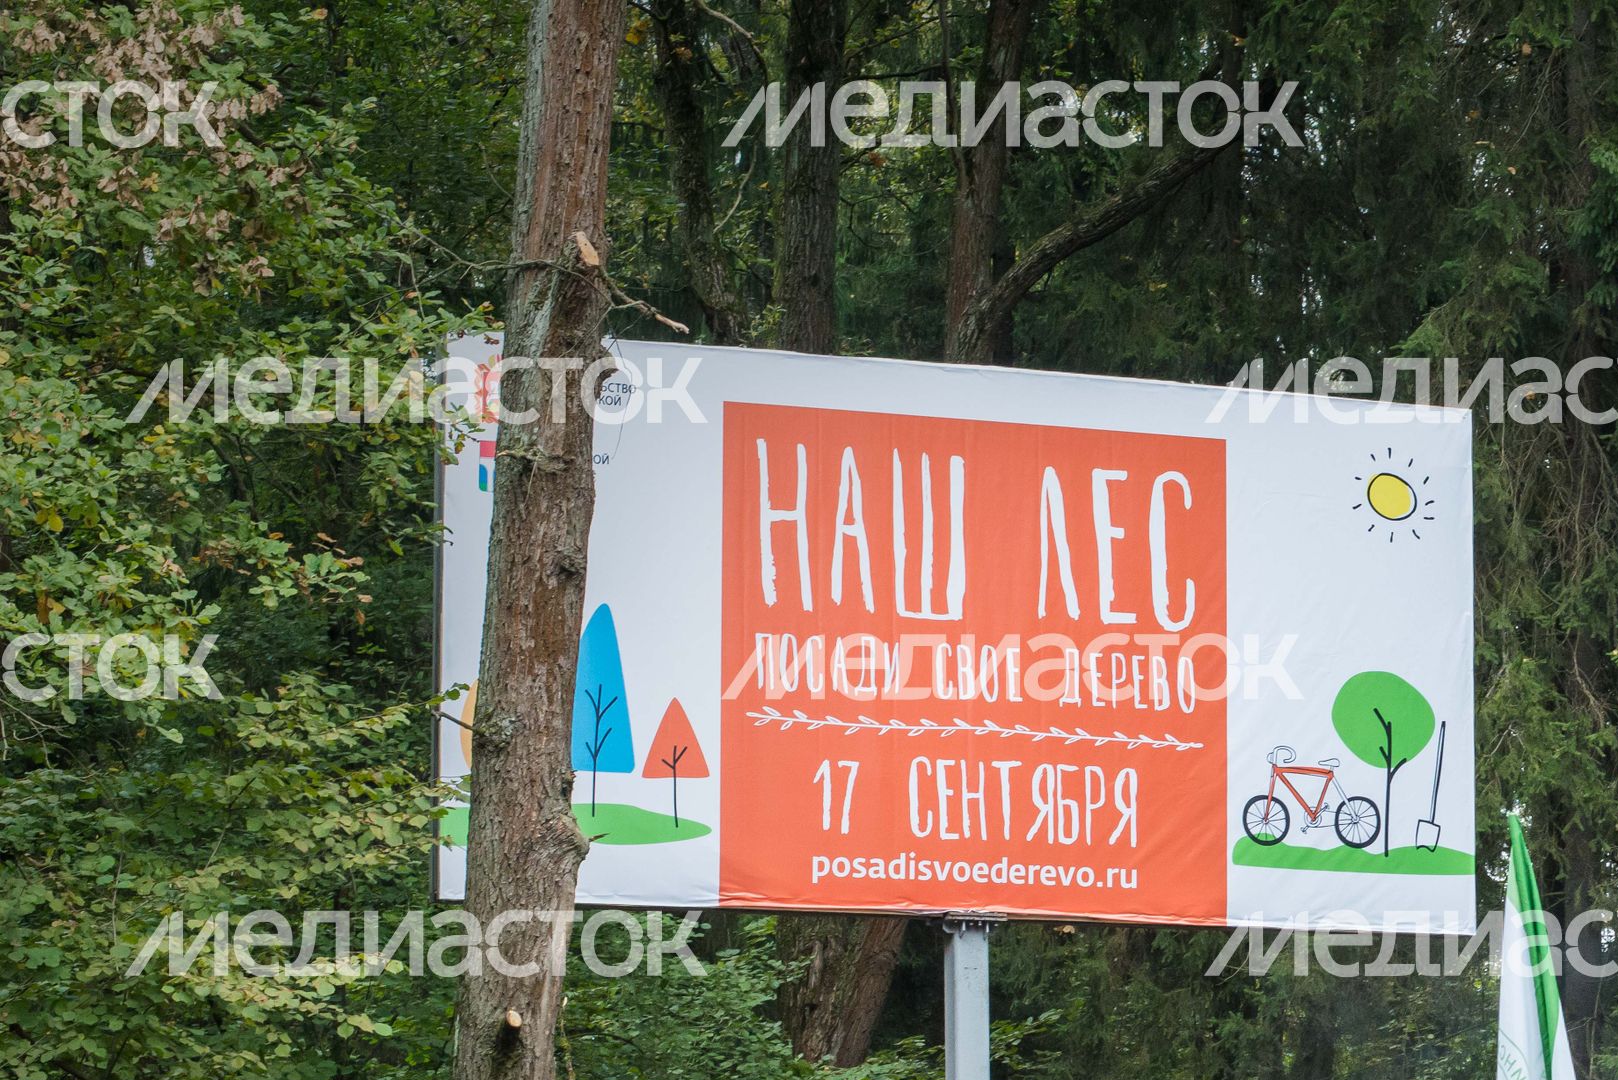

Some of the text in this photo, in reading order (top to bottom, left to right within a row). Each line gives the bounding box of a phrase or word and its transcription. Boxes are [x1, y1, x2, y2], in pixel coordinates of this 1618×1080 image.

[755, 437, 1197, 634] НАШ ЛЕС
[754, 632, 1197, 714] ПОСАДИ СВОЕ ДЕРЕВО
[812, 755, 1139, 848] 17 СЕНТЯБРЯ
[811, 850, 1139, 892] posadisvoederevo.ru
